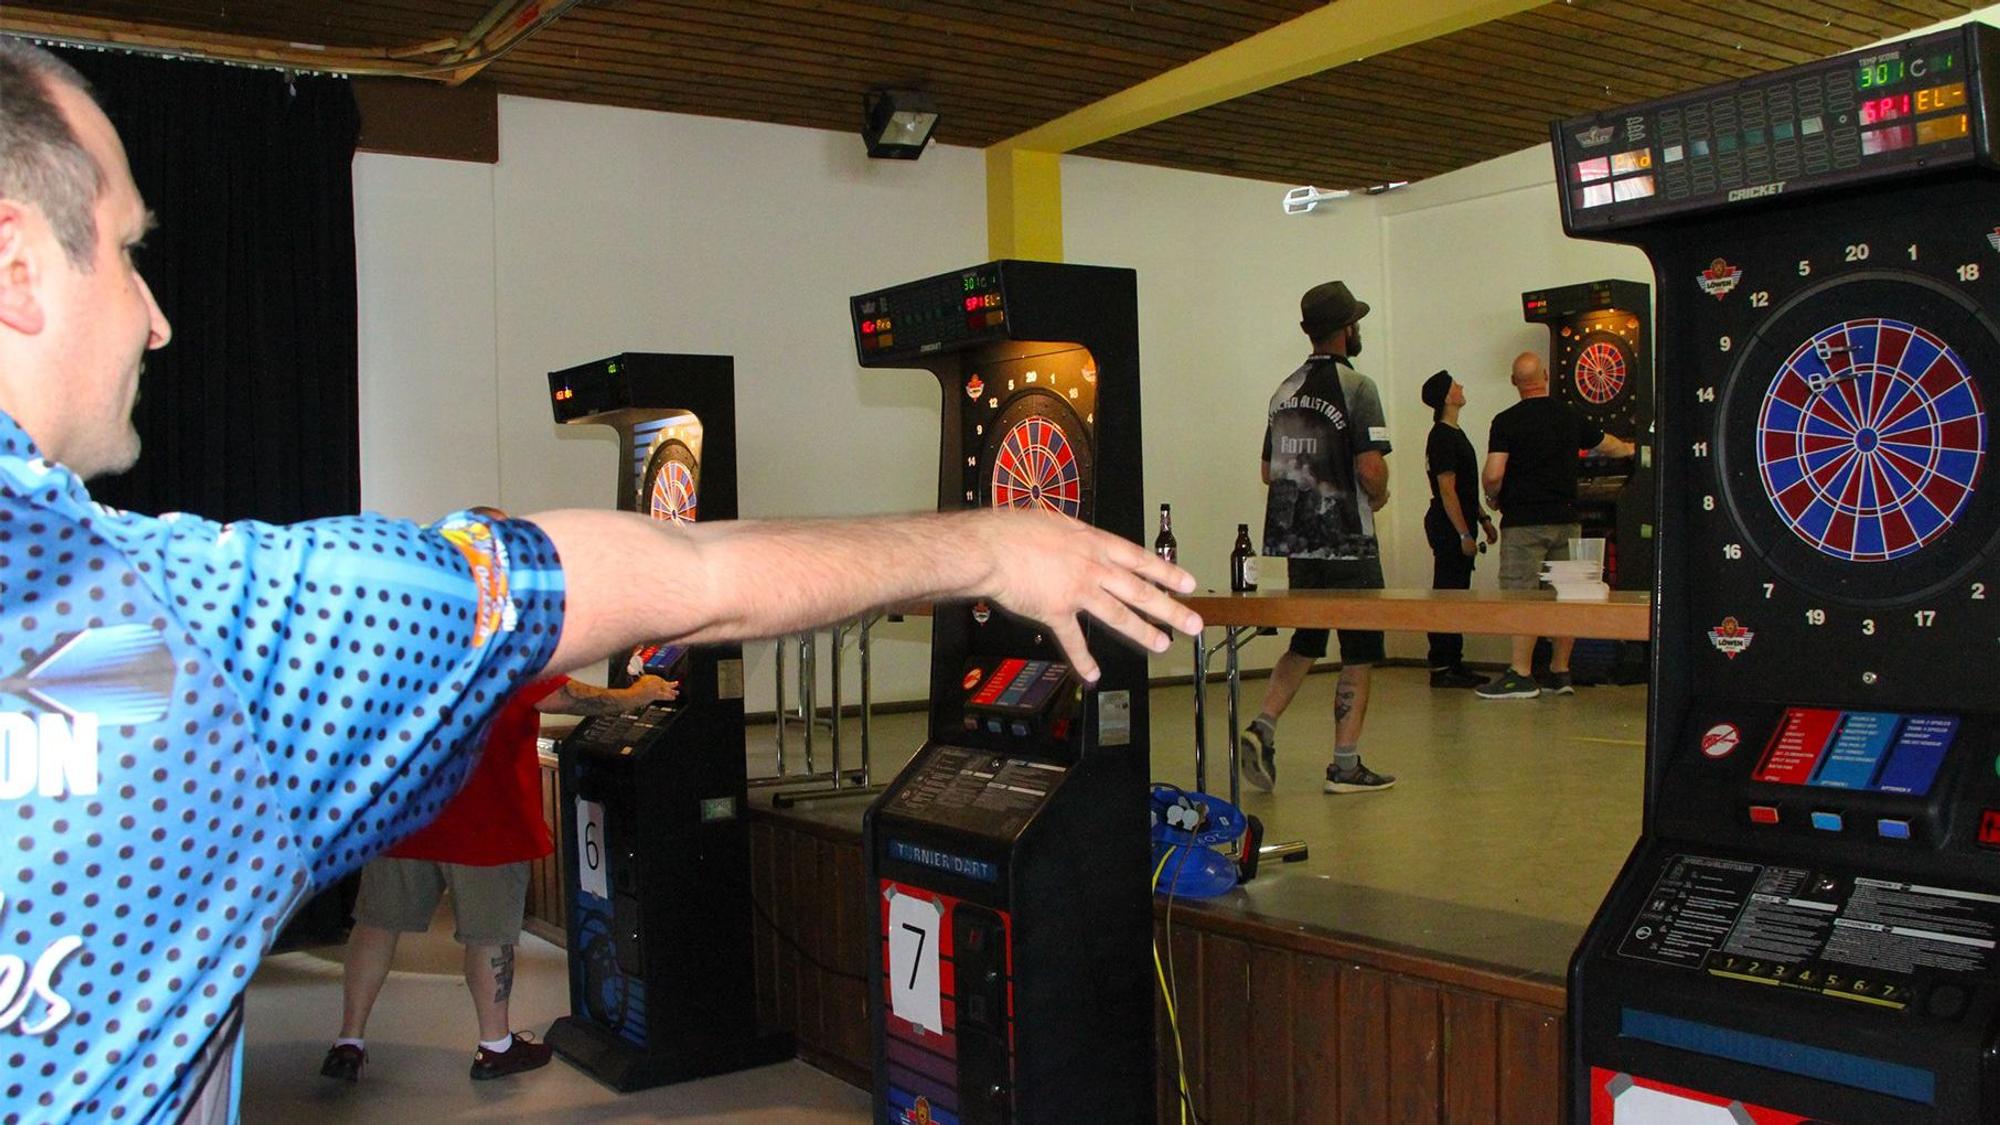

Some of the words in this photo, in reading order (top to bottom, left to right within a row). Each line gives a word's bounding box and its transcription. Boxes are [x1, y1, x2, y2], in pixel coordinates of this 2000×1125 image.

[1728, 181, 1786, 202] CRICKET
[1845, 243, 1869, 262] 20
[1907, 244, 1918, 261] 1
[1799, 260, 1811, 276] 5
[1956, 263, 1979, 282] 18
[1750, 291, 1769, 308] 12
[1719, 336, 1731, 351] 9
[1008, 379, 1015, 390] 5
[1026, 370, 1038, 383] 20
[989, 397, 998, 409] 12
[1696, 387, 1715, 403] 14
[1086, 413, 1094, 423] 4
[976, 424, 983, 435] 9
[1692, 442, 1708, 457] 11
[1703, 495, 1714, 511] 8
[1723, 543, 1742, 560] 16
[1763, 583, 1774, 599] 7
[1971, 583, 1985, 599] 2
[1805, 609, 1826, 625] 19
[1914, 610, 1936, 627] 17
[1862, 619, 1875, 635] 3
[585, 821, 599, 871] 6
[954, 857, 989, 878] DART
[902, 922, 926, 990] 7
[1749, 961, 1759, 972] 2
[1775, 965, 1786, 976] 3
[1799, 969, 1811, 981] 4
[1826, 974, 1839, 985] 5
[1852, 979, 1866, 990] 6
[1882, 985, 1894, 996] 7
